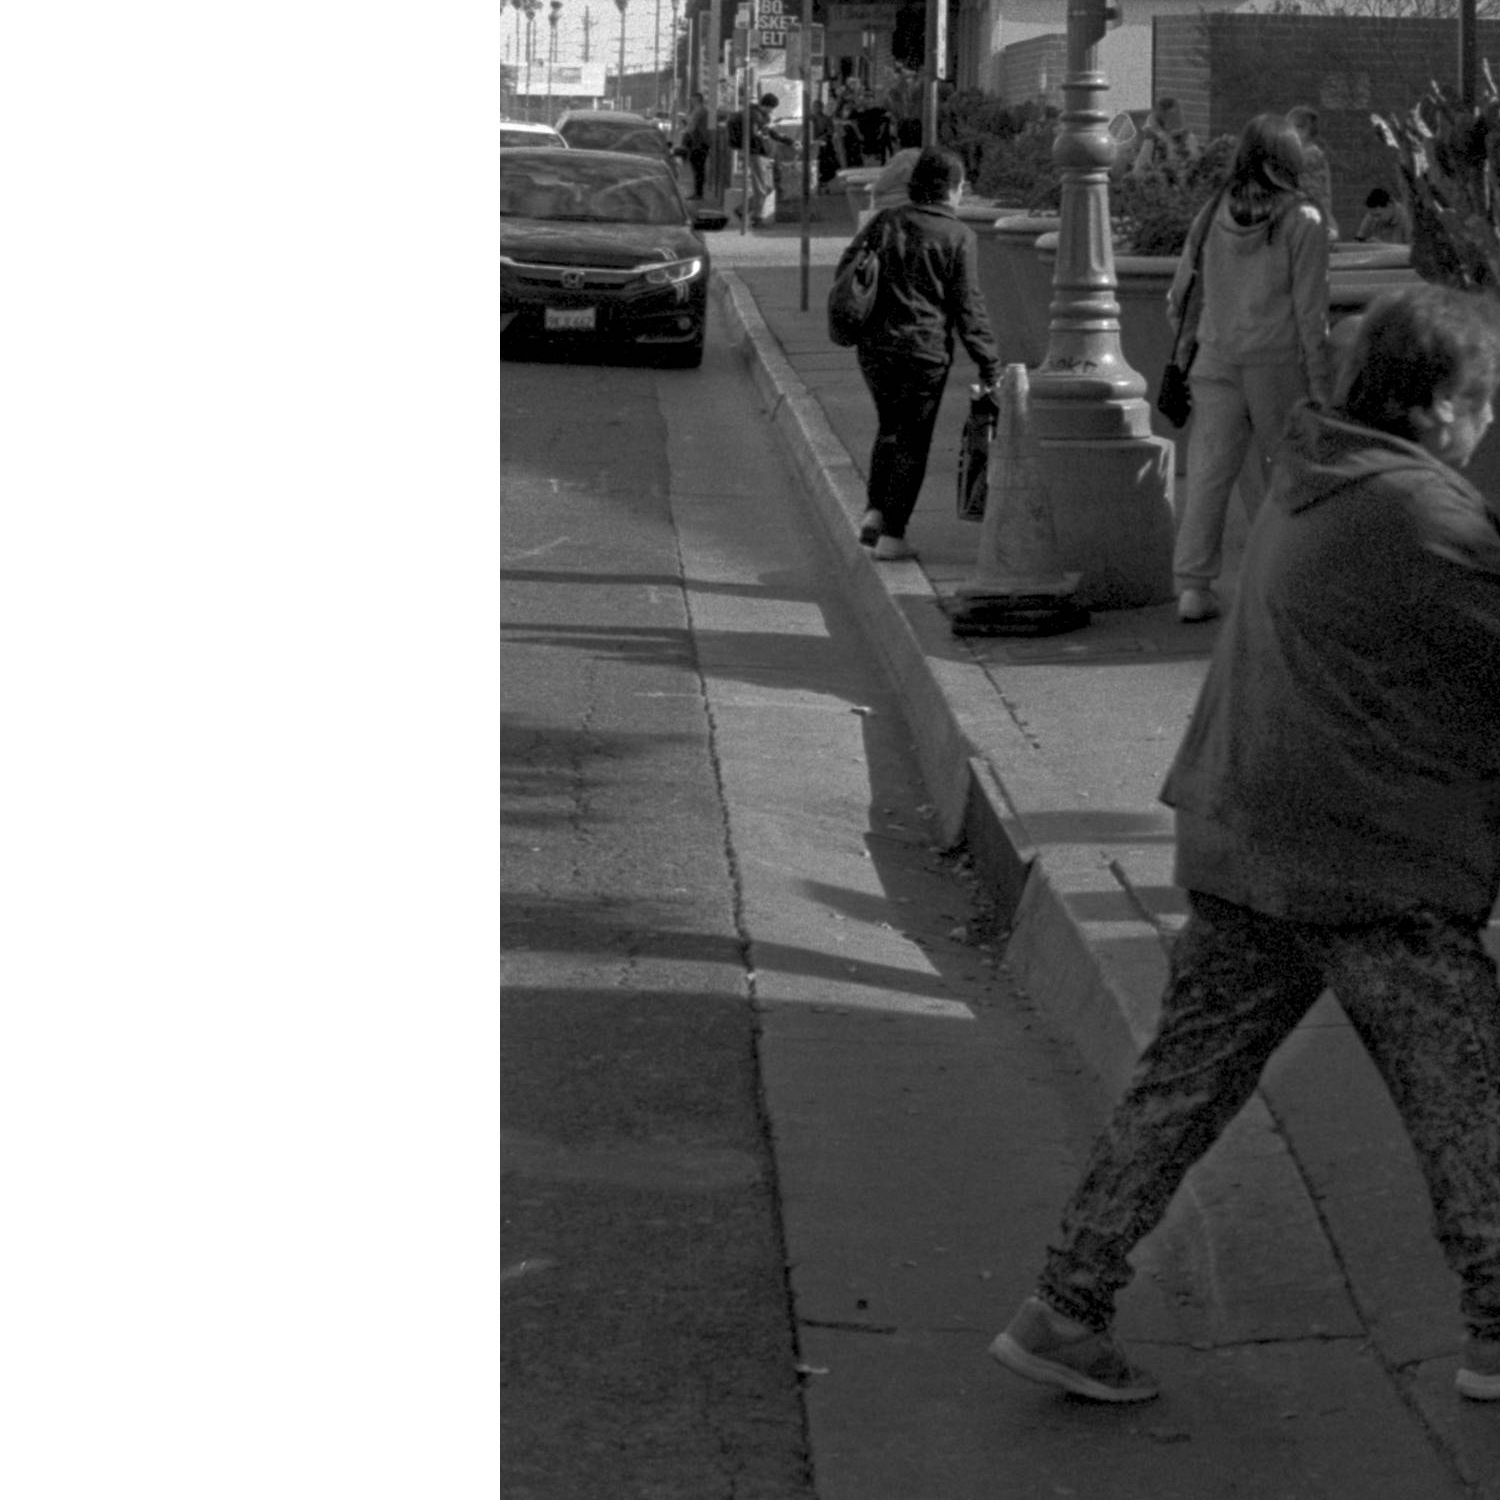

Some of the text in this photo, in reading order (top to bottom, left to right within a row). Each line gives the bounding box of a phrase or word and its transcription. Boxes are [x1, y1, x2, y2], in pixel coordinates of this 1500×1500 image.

[760, 0, 784, 14] BQ
[758, 15, 800, 31] SKET
[761, 31, 785, 46] ELT
